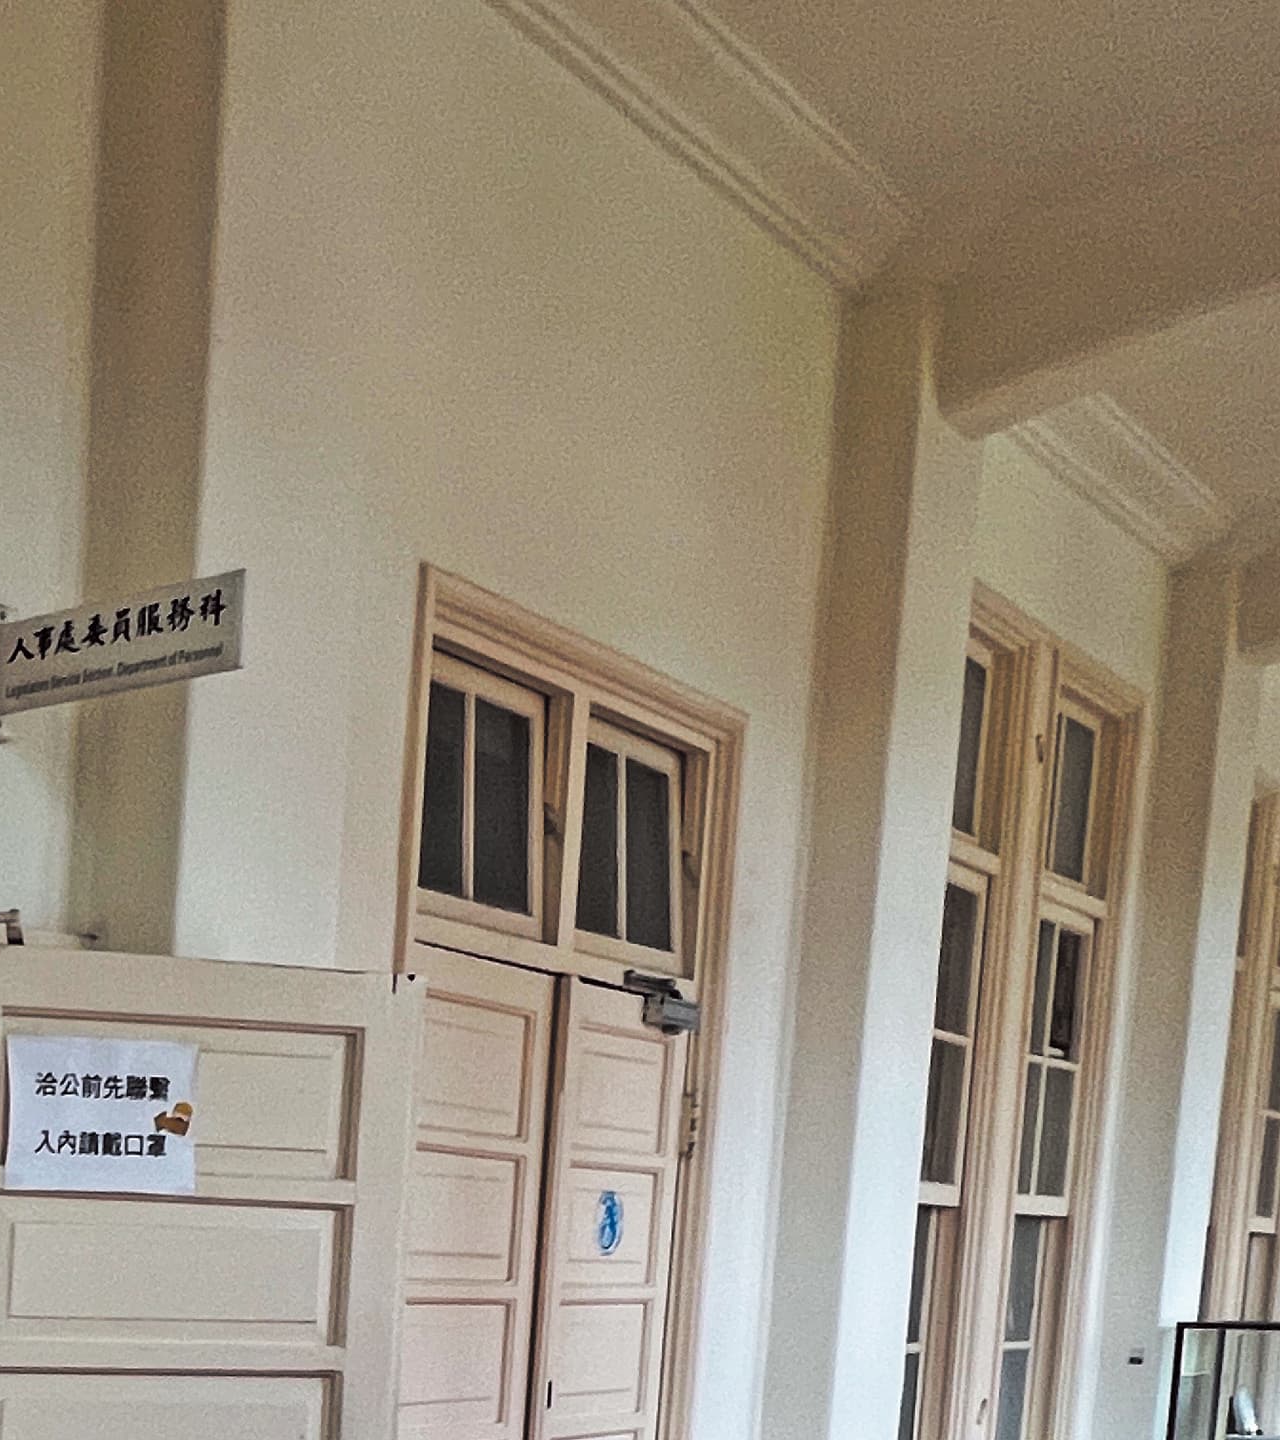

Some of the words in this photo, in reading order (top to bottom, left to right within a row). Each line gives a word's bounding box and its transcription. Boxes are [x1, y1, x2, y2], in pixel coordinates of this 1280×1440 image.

[7, 589, 226, 664] 人事處委員服務科
[35, 1072, 171, 1101] 洽公前先聯繫
[34, 1129, 168, 1158] 入內請戴口罩
